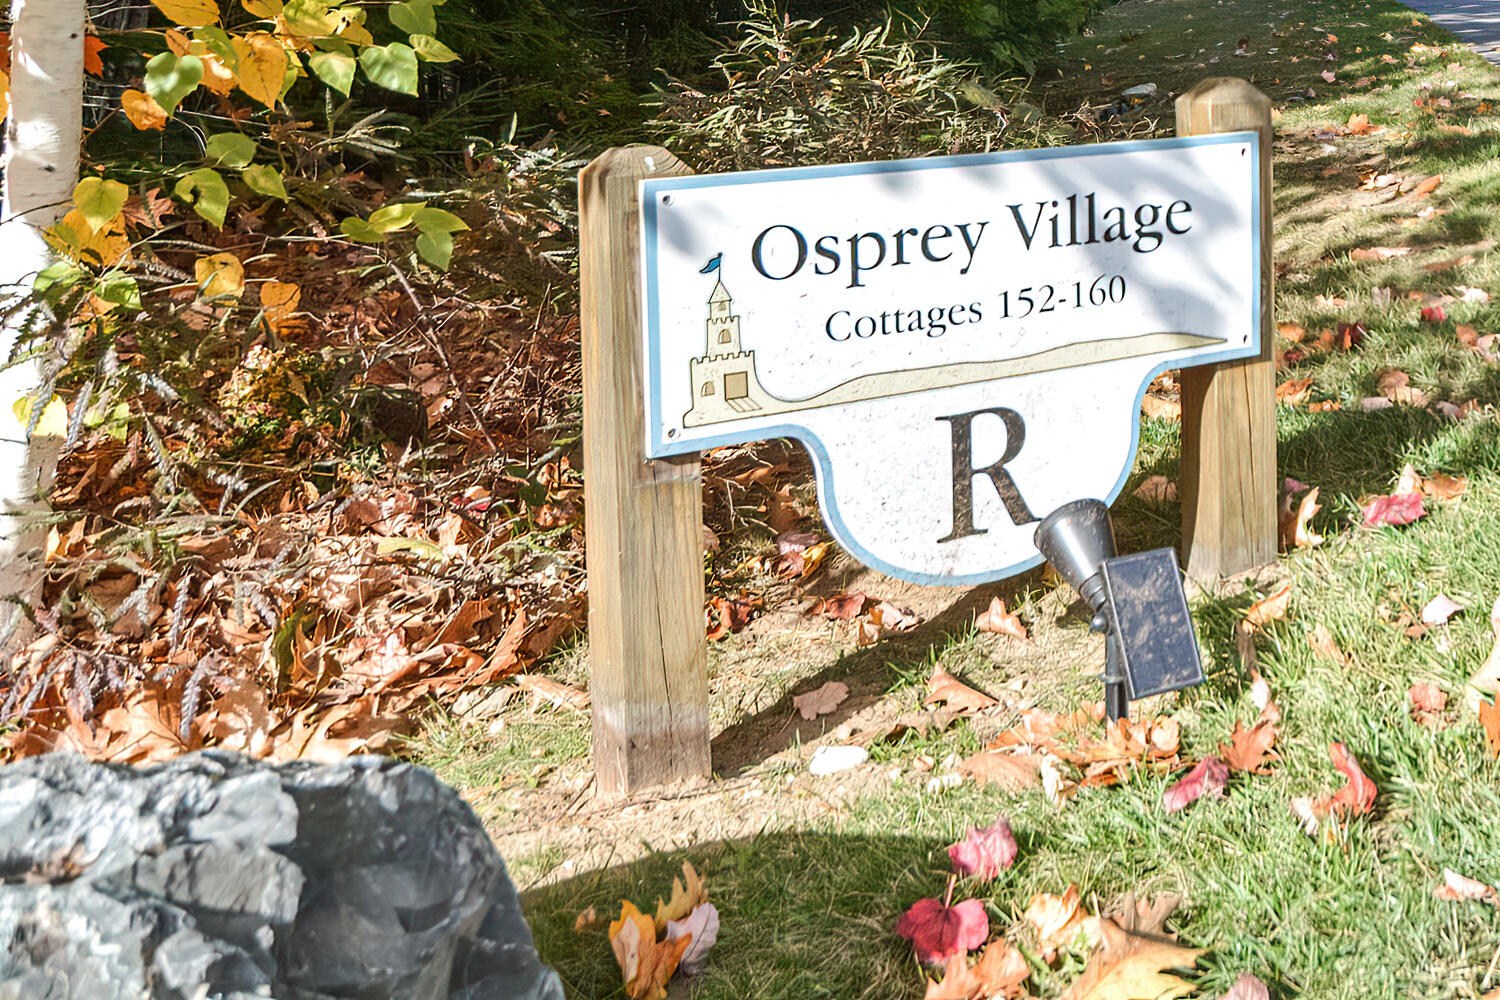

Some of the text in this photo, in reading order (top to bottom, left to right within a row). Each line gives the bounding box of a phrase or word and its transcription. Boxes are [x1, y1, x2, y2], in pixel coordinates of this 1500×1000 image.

[750, 192, 1194, 289] Osprey Village
[825, 273, 1127, 341] Cottages 152-160
[934, 406, 1043, 545] R
